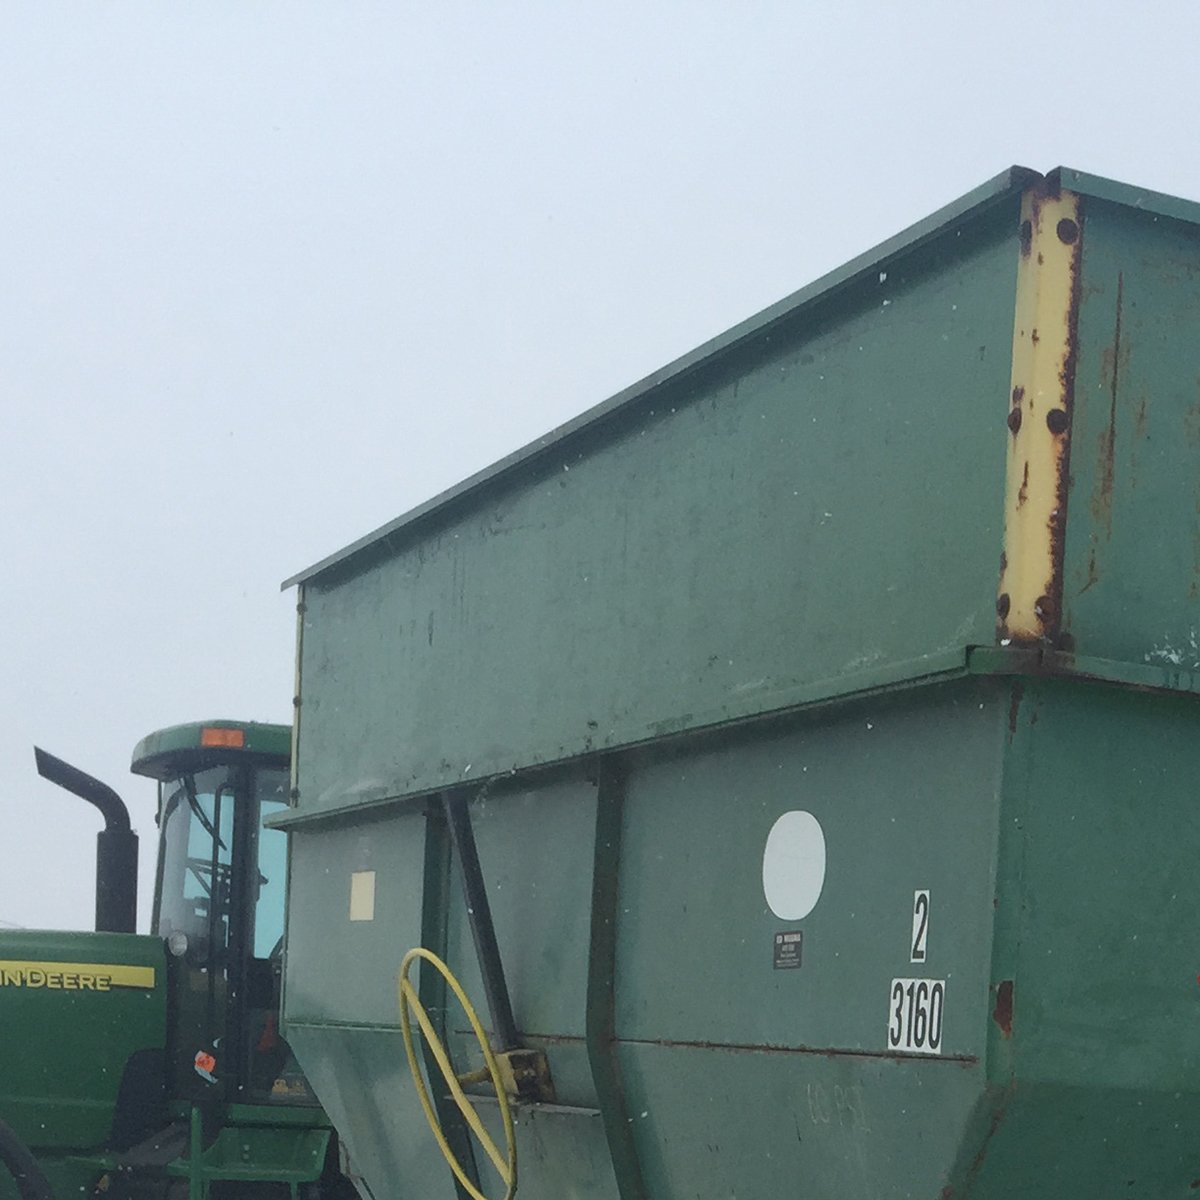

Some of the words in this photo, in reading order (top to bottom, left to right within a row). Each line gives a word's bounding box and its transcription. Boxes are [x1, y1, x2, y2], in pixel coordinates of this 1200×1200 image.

[912, 893, 928, 960] 2
[0, 969, 22, 987] N
[26, 968, 111, 991] DEERE
[890, 982, 943, 1050] 3160
